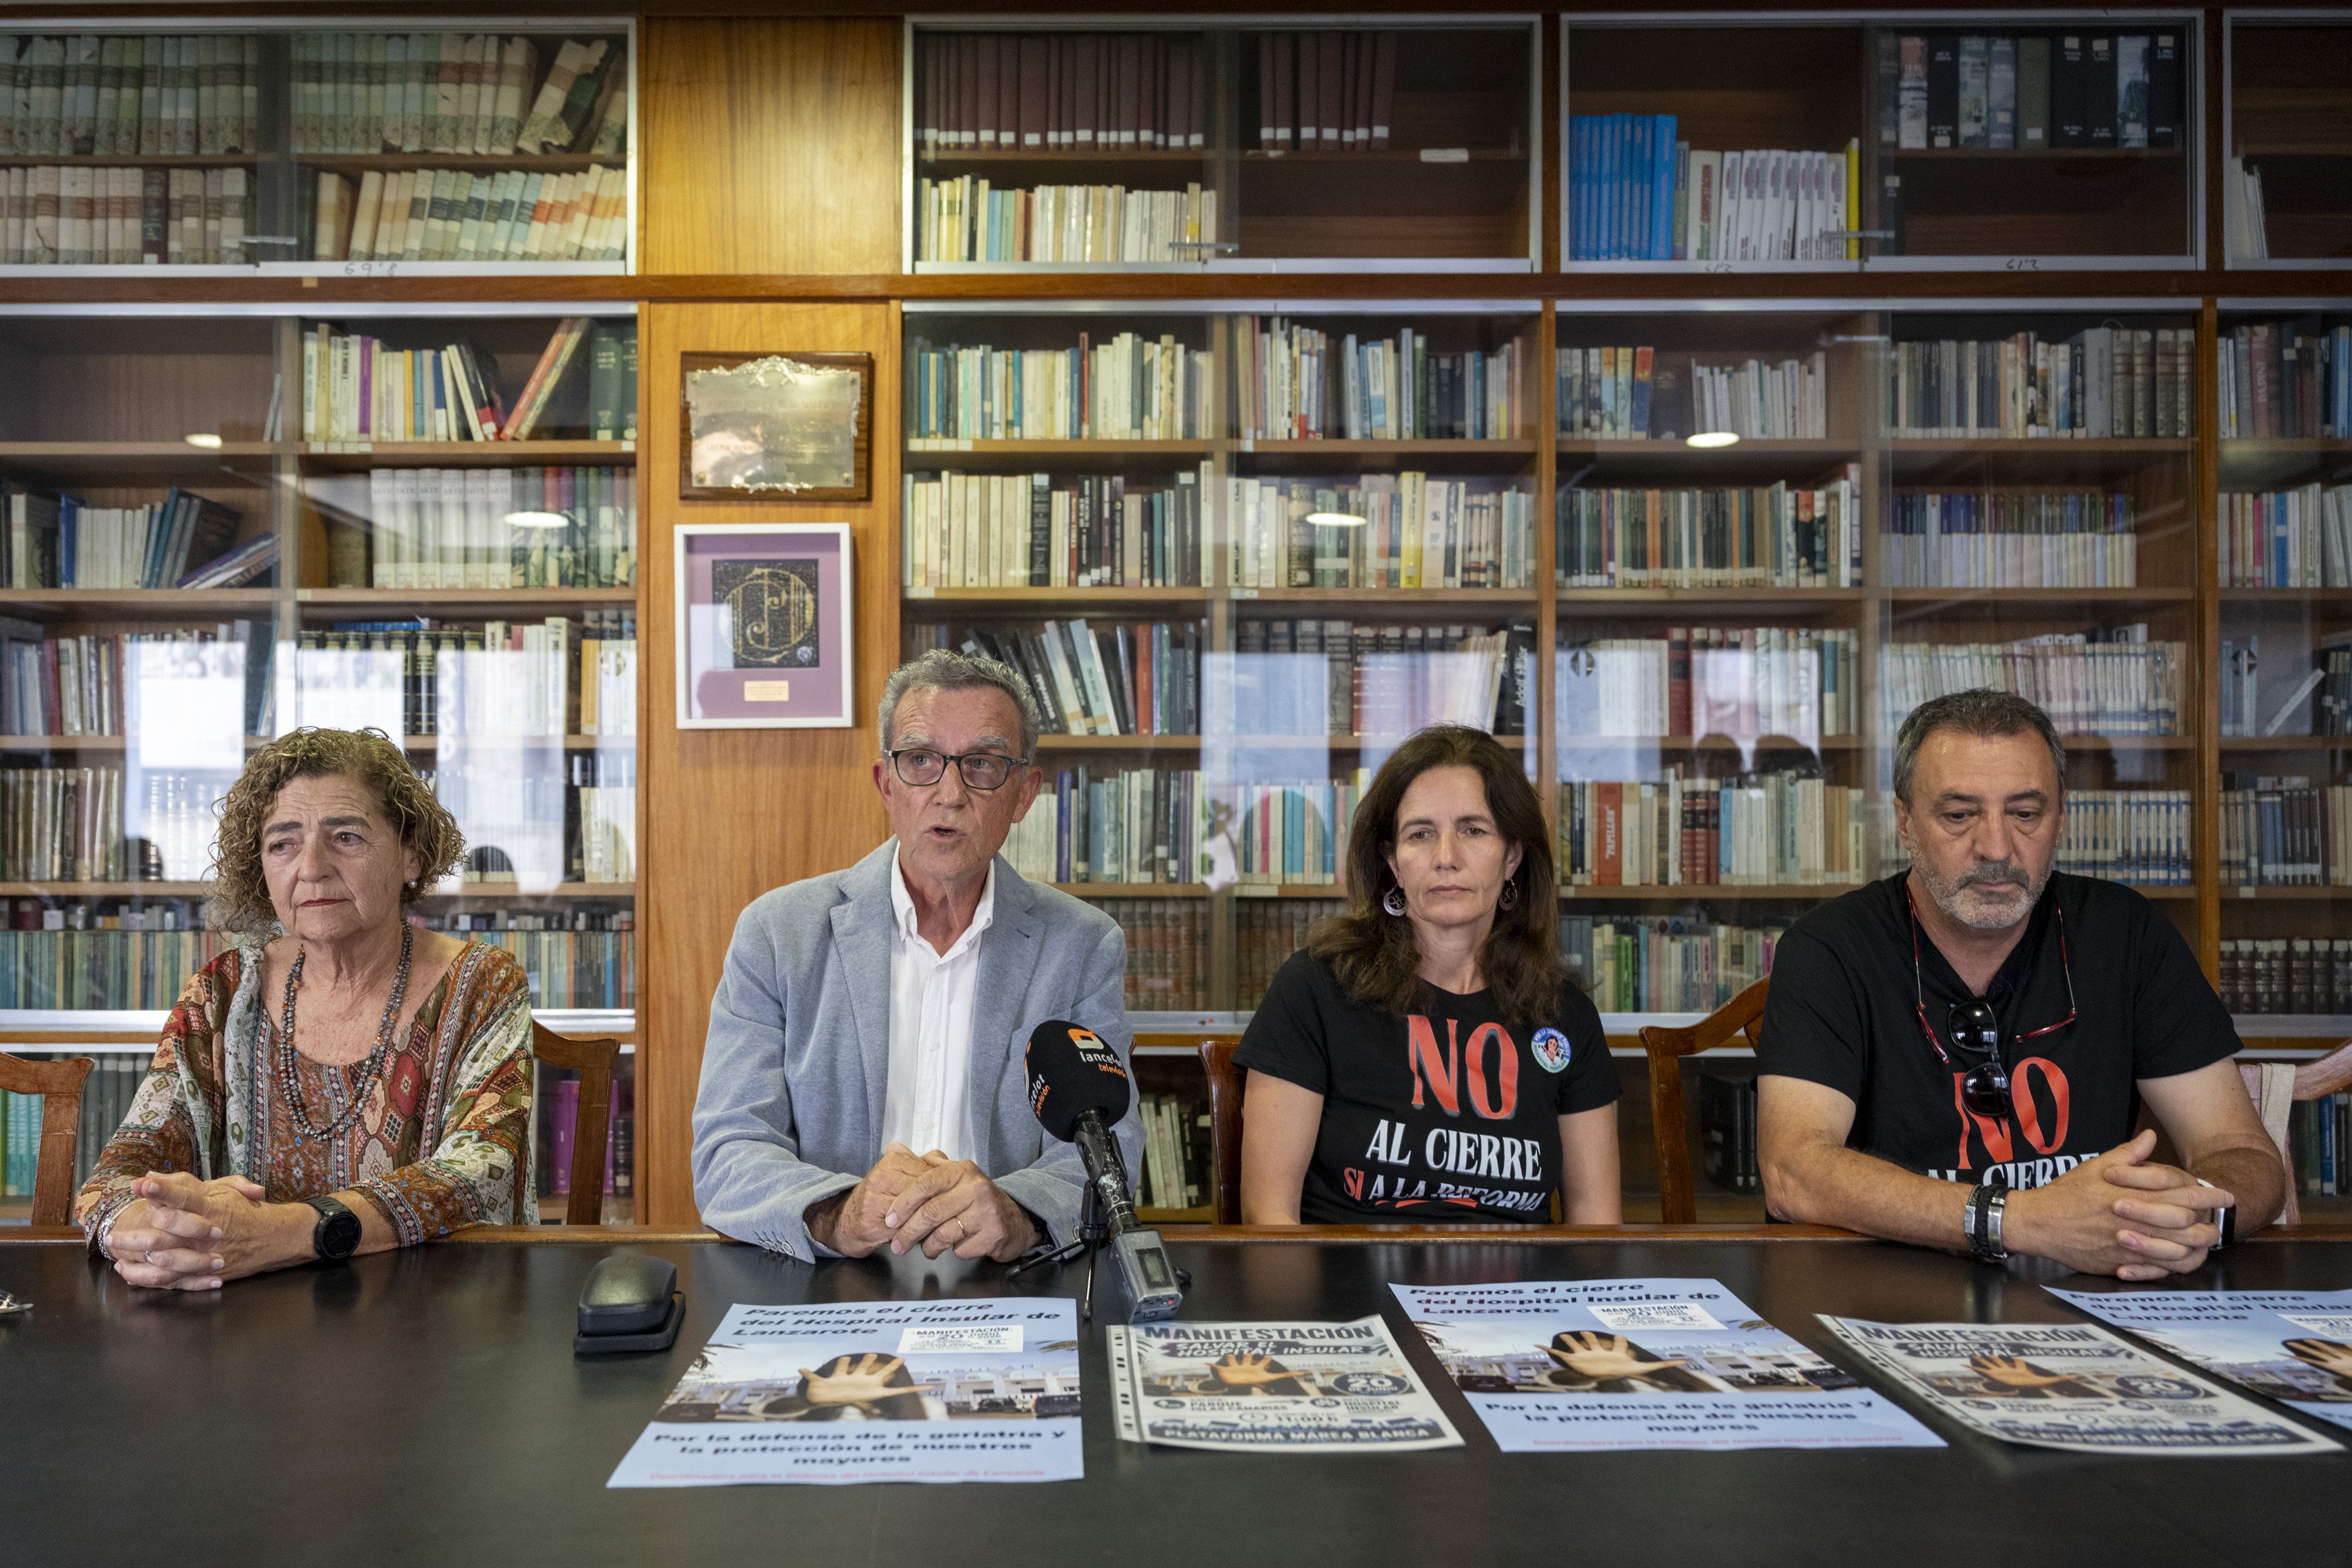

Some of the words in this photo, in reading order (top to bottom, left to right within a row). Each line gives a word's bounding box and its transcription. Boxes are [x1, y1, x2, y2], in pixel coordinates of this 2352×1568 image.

[1407, 1014, 1519, 1120] NO
[1953, 1056, 2070, 1170] NO
[1366, 1118, 1411, 1166] AL
[1425, 1127, 1542, 1182] CIERRE
[1343, 1166, 1365, 1201] SI
[1368, 1174, 1386, 1201] A
[1391, 1177, 1427, 1200] LA
[1565, 1283, 1645, 1293] cierre
[1467, 1296, 1578, 1307] Hospital
[1587, 1293, 1680, 1302] Insular
[2068, 1293, 2187, 1302] Paremos
[2227, 1293, 2307, 1302] cierre
[745, 1307, 868, 1316] Paremos
[876, 1306, 903, 1314] el
[910, 1303, 994, 1313] cierre
[1422, 1306, 1561, 1315] Lanzarote
[2138, 1303, 2254, 1313] Hospital
[793, 1317, 913, 1326] Hospital
[919, 1313, 1020, 1323] Insular
[732, 1328, 879, 1336] Lanzarote
[1143, 1325, 1375, 1341] MANIFESTACIÓN
[1857, 1326, 2101, 1343] MANIFESTACIÓN
[1175, 1340, 1251, 1349] SALVAR
[1176, 1347, 1274, 1357] HOSPITAL
[1283, 1345, 1365, 1354] INSULAR
[1346, 1376, 1388, 1387] 20
[1357, 1428, 1430, 1439] BLANCA
[1647, 1424, 1760, 1433] mayores
[706, 1434, 730, 1442] la
[740, 1433, 845, 1441] defensa
[1051, 1430, 1066, 1439] y
[871, 1443, 903, 1451] de
[913, 1442, 1032, 1450] nuestros
[793, 1456, 911, 1466] mayores
